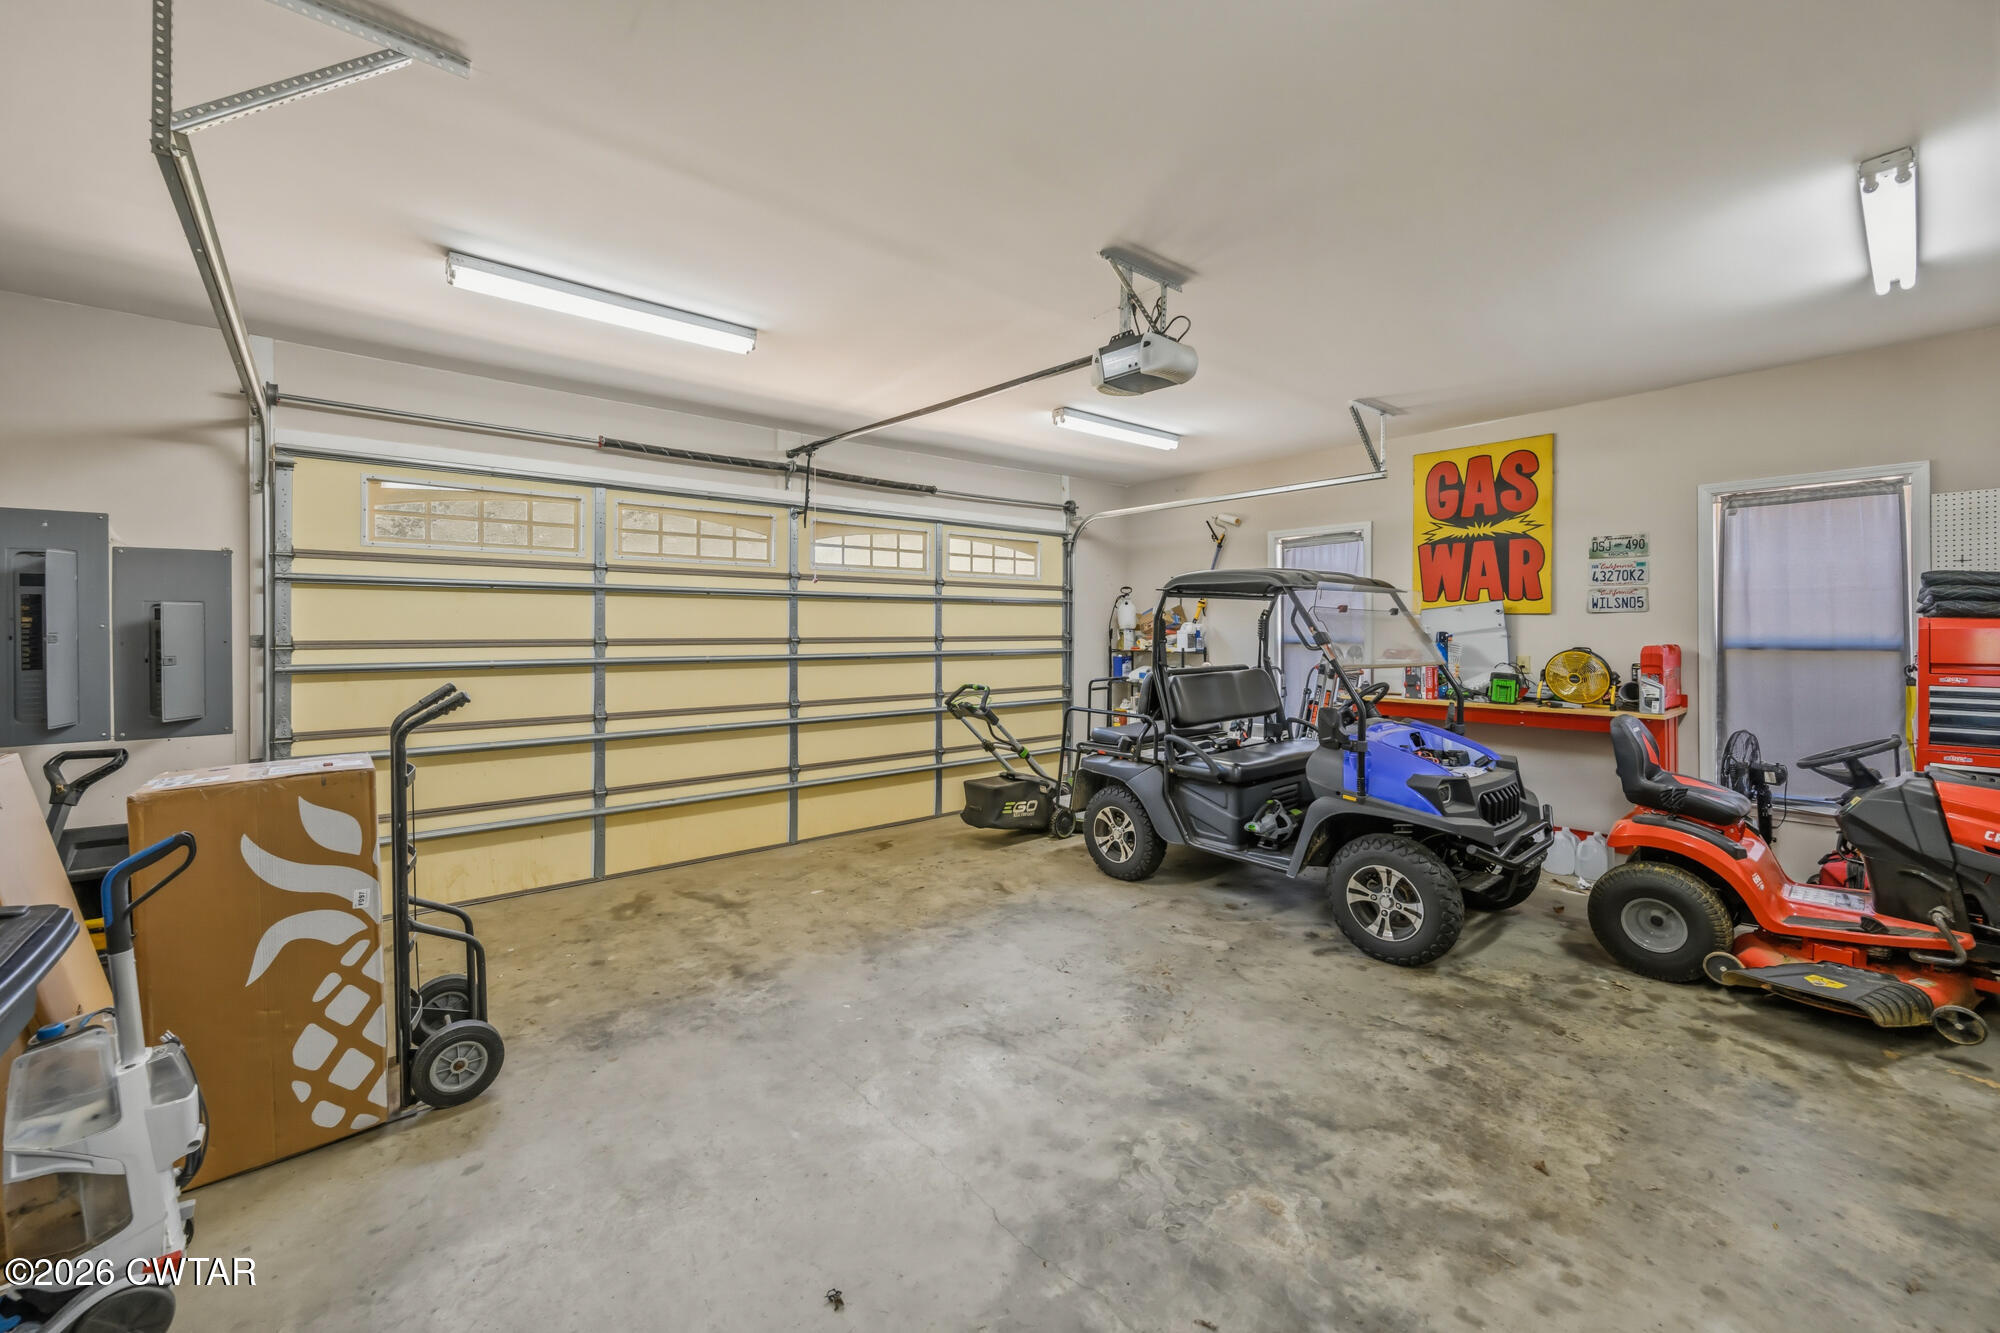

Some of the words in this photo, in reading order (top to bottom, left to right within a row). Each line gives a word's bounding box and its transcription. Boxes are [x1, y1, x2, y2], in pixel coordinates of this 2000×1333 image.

[1425, 449, 1539, 520] GAS
[1592, 541, 1611, 552] DSJ
[1625, 538, 1645, 550] 490
[1418, 538, 1545, 602] WAR
[1002, 800, 1038, 813] EGO
